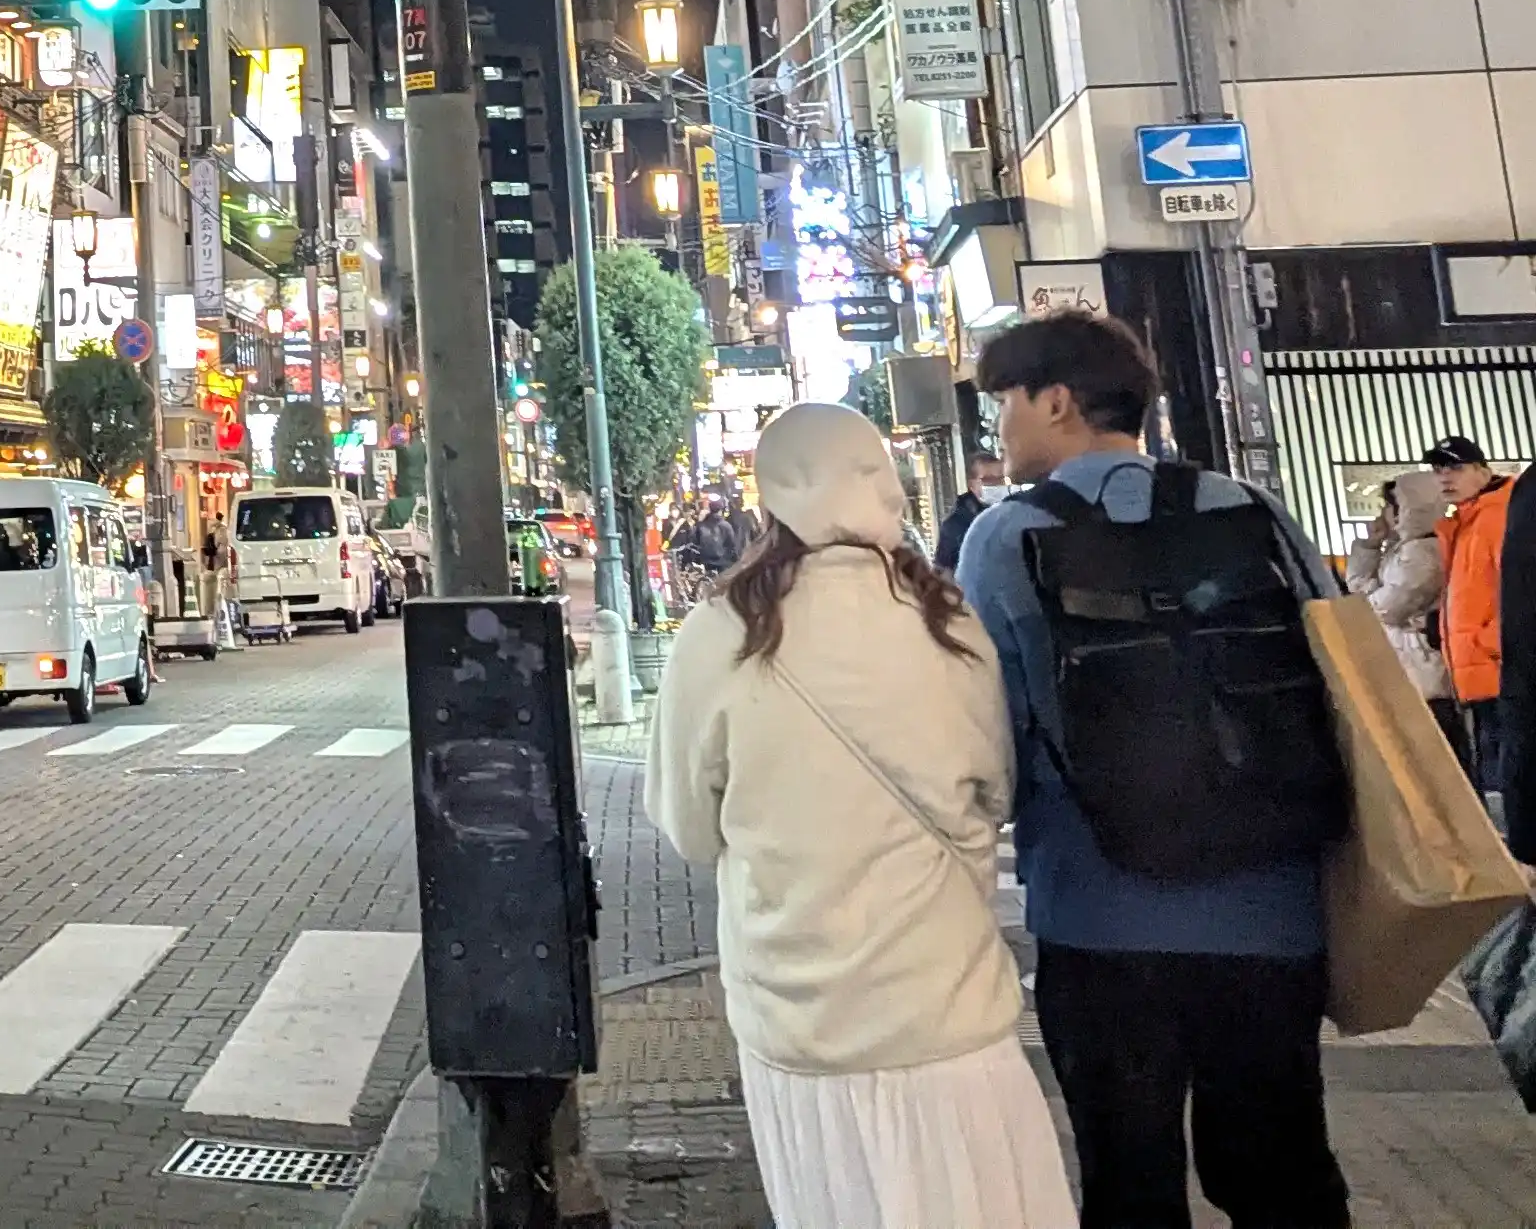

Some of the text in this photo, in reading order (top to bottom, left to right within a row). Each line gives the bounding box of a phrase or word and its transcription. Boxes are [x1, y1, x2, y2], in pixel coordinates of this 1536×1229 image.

[405, 30, 427, 50] 07
[907, 52, 978, 68] ワカノウラ薬局
[1164, 192, 1237, 214] 自転車を除く
